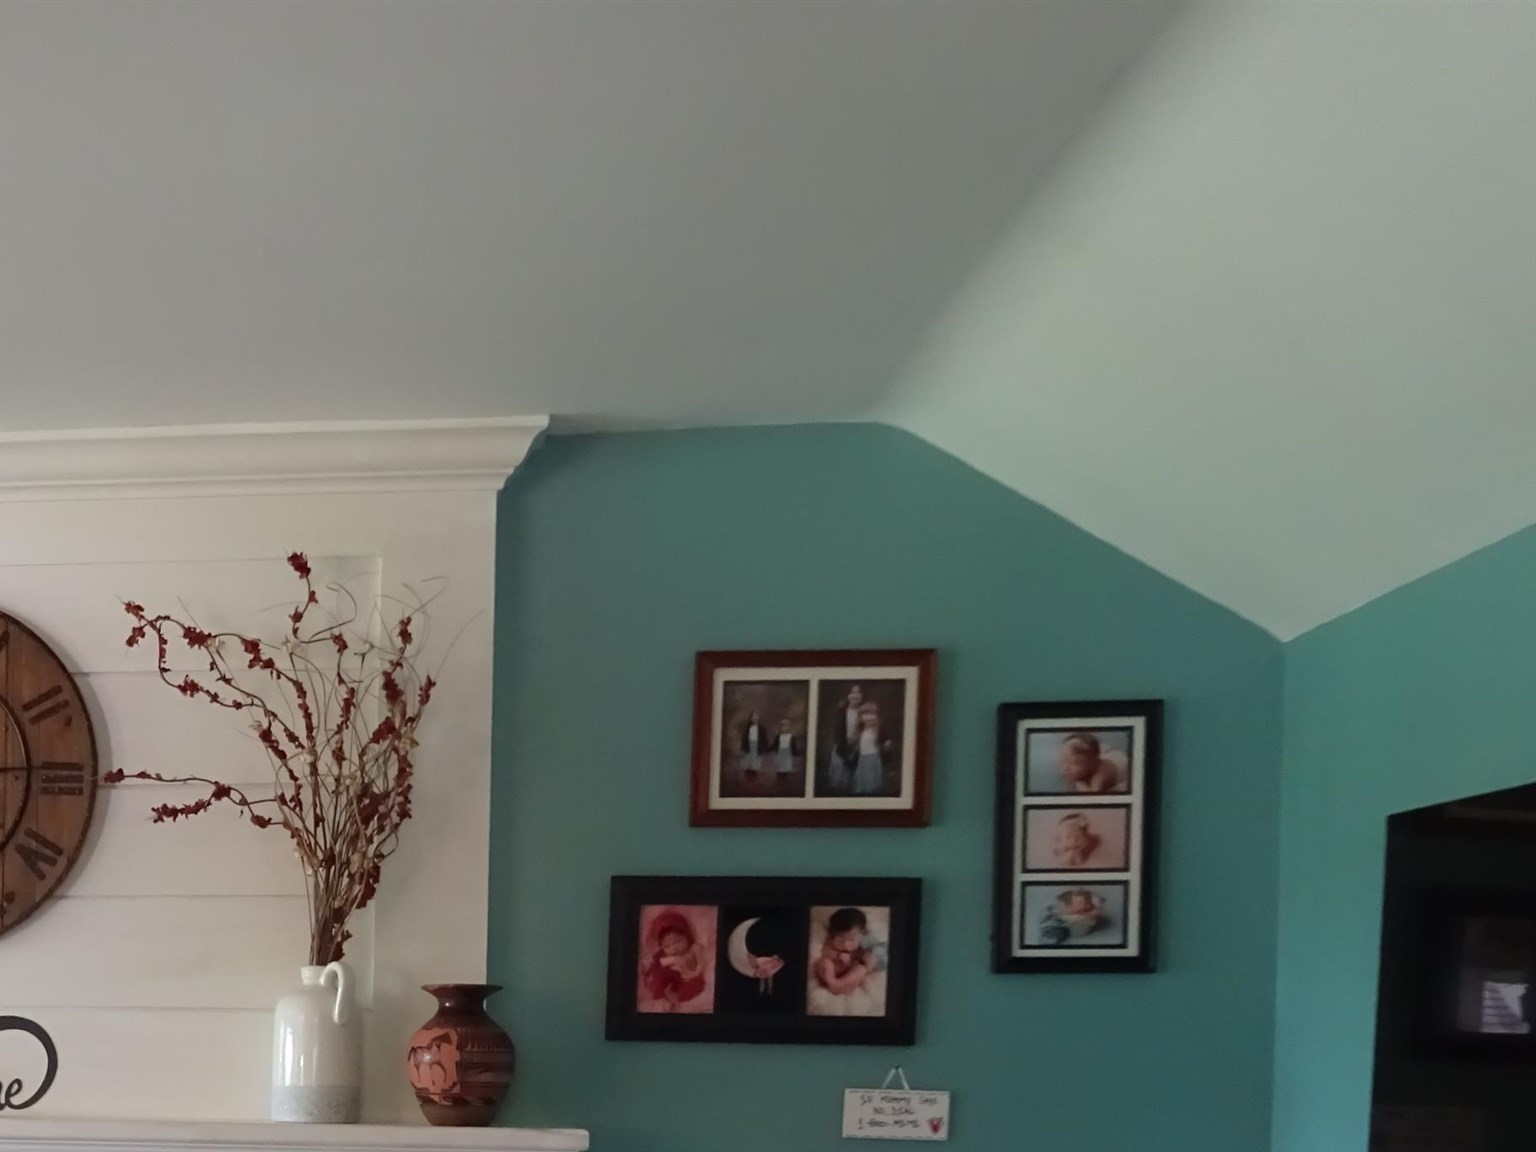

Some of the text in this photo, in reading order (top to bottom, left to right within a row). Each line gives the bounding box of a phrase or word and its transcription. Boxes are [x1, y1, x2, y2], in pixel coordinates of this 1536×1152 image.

[21, 684, 70, 725] II
[40, 761, 84, 796] III
[15, 827, 64, 881] IV
